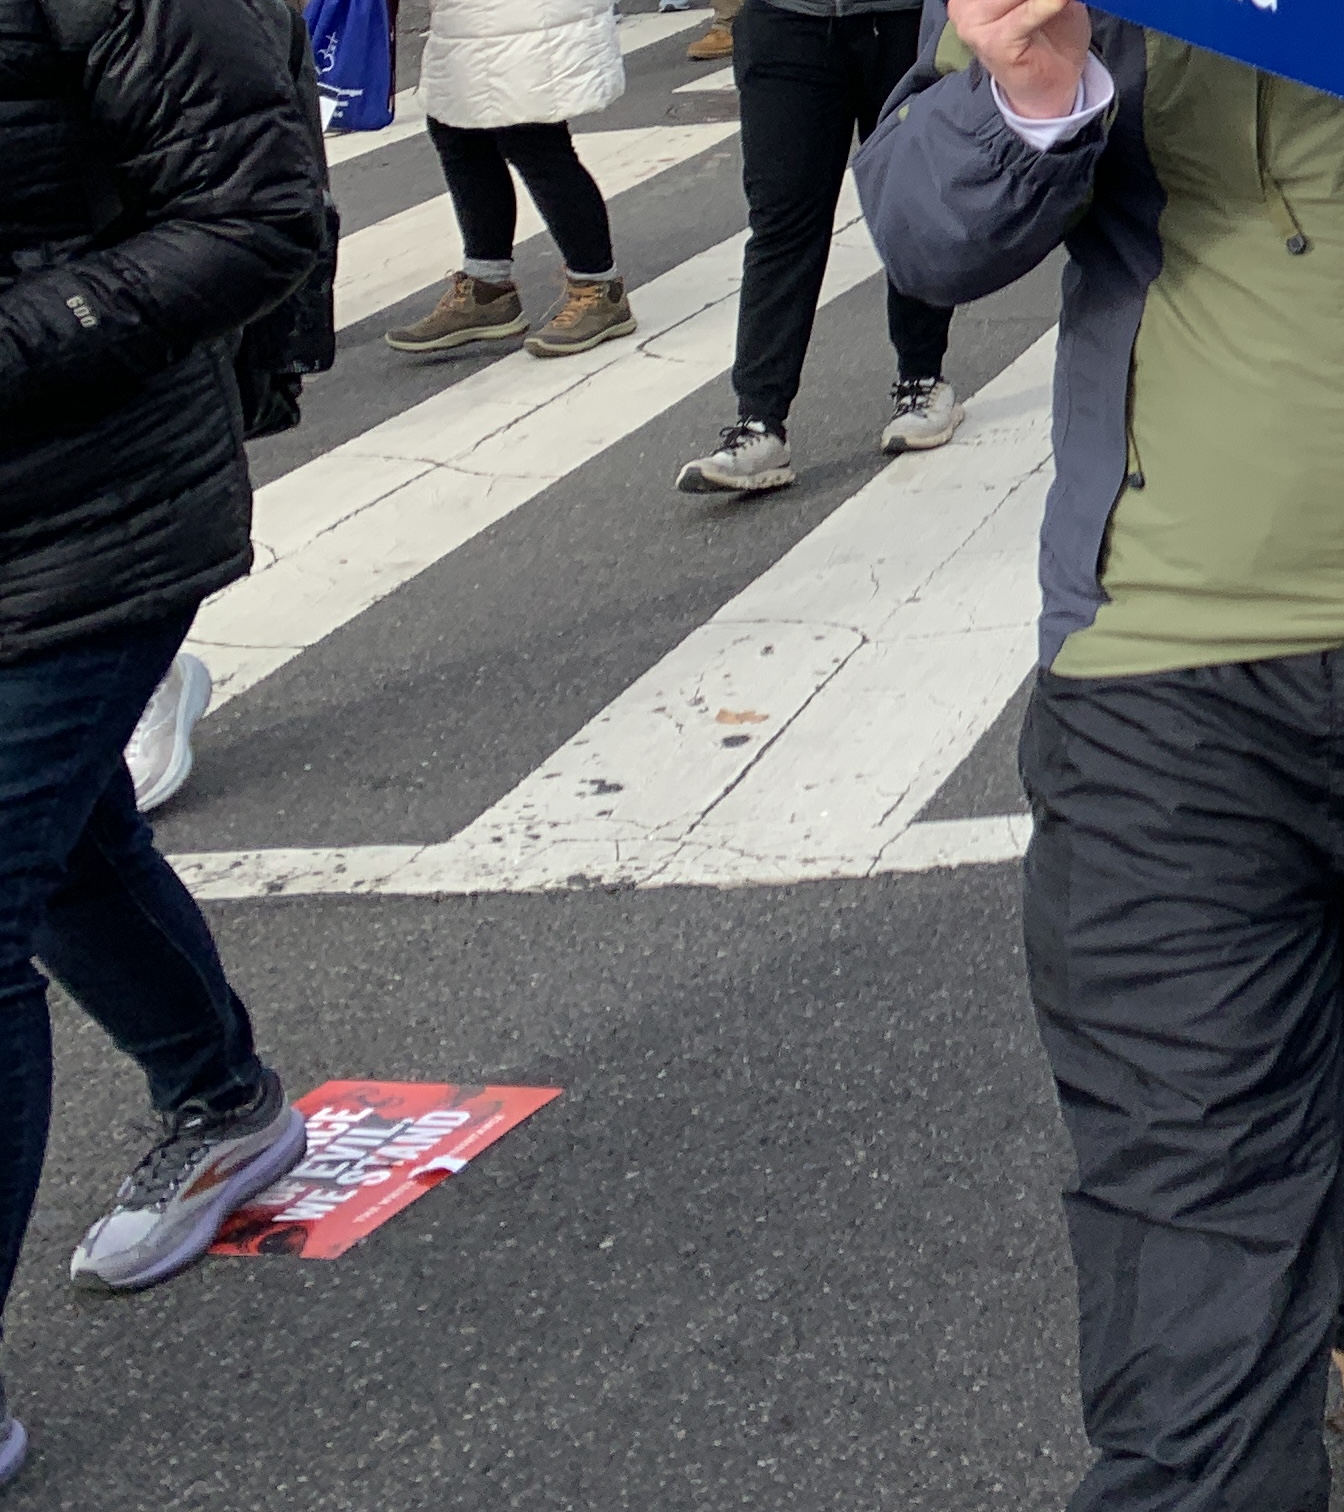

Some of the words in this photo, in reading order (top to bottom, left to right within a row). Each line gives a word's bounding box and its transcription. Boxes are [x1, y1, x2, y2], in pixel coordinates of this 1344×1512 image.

[271, 1189, 357, 1223] WE
[336, 1110, 472, 1187] STAND
[292, 1118, 415, 1179] EVIL,
